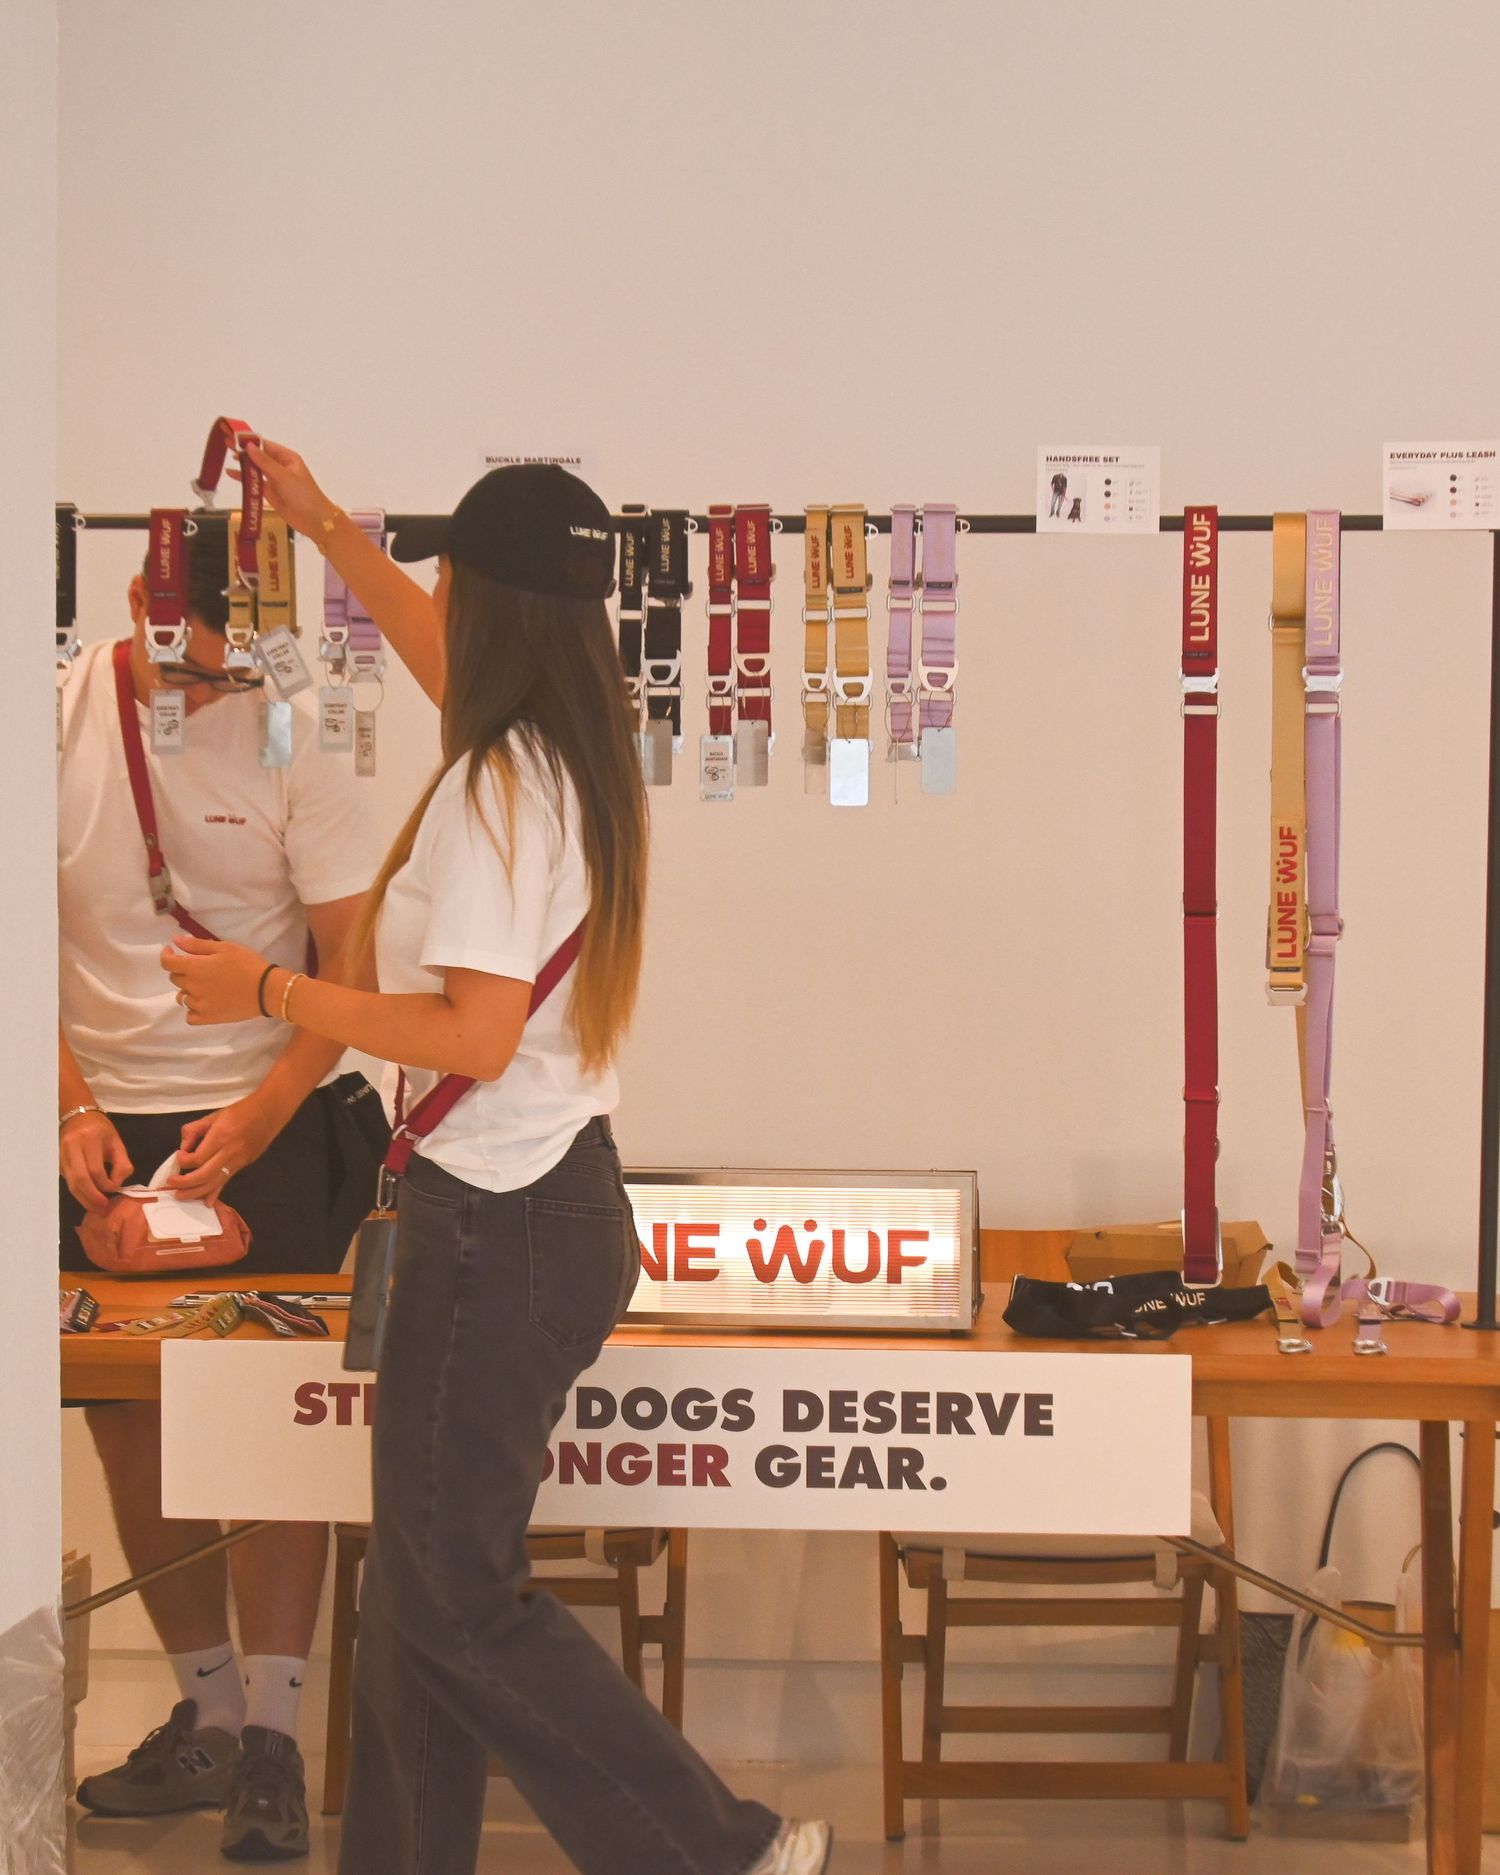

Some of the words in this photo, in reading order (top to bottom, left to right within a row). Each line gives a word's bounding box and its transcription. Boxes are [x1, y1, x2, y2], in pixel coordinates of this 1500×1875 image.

[485, 456, 521, 464] BUCKLE
[523, 456, 581, 464] MARTINGALE
[1045, 455, 1100, 463] HANDSFREE
[1103, 455, 1120, 463] SET
[1440, 451, 1464, 459] PLUS
[1466, 450, 1497, 458] LEASH
[569, 526, 592, 538] LUNE
[1189, 573, 1211, 642] LUNE
[1313, 578, 1333, 646] LUNE
[1277, 890, 1298, 959] LUNE
[639, 1222, 721, 1282] NE
[575, 1385, 757, 1432] DOGS
[782, 1389, 1055, 1437] DESERVE
[538, 1441, 732, 1487] NGER
[753, 1443, 948, 1492] GEAR.
